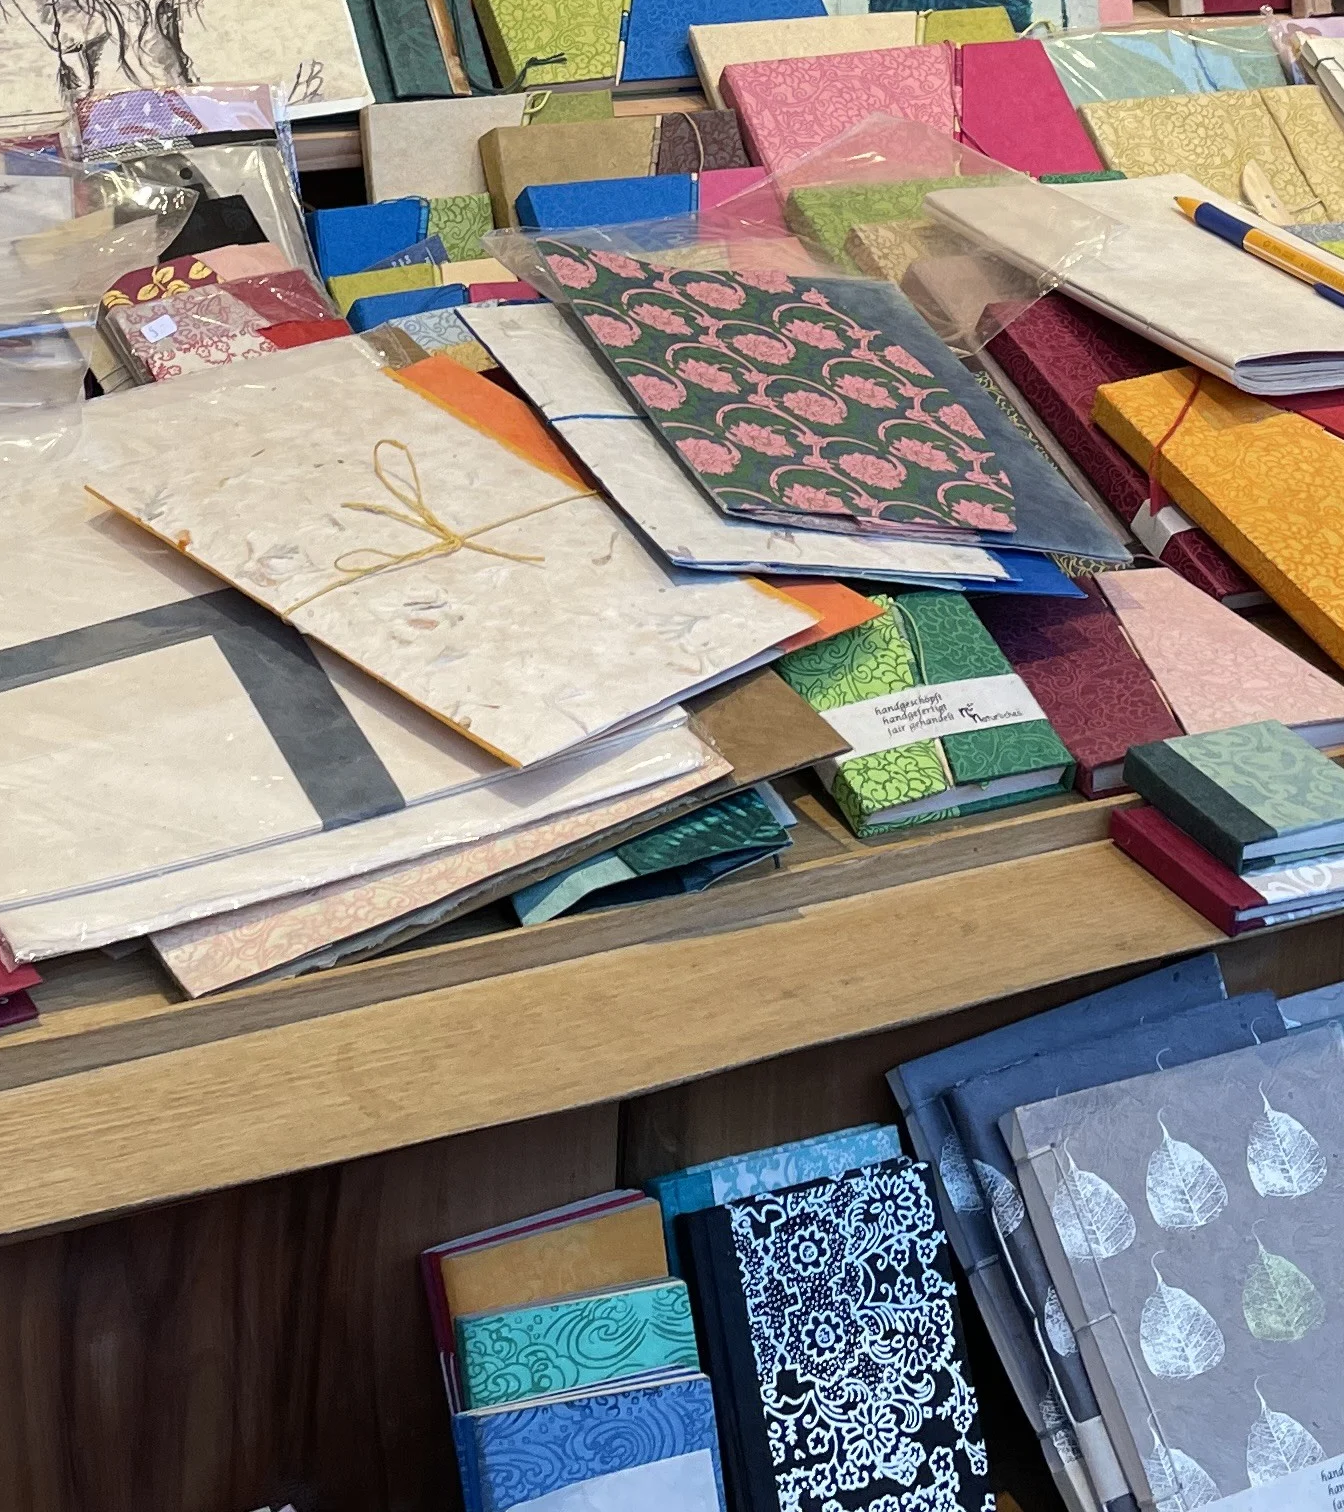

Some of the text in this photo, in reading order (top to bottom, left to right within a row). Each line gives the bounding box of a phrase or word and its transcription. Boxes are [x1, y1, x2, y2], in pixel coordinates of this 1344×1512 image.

[875, 692, 942, 715] handgeschöpft
[882, 703, 947, 726] handgefertigt
[888, 713, 954, 737] fair gehandelt
